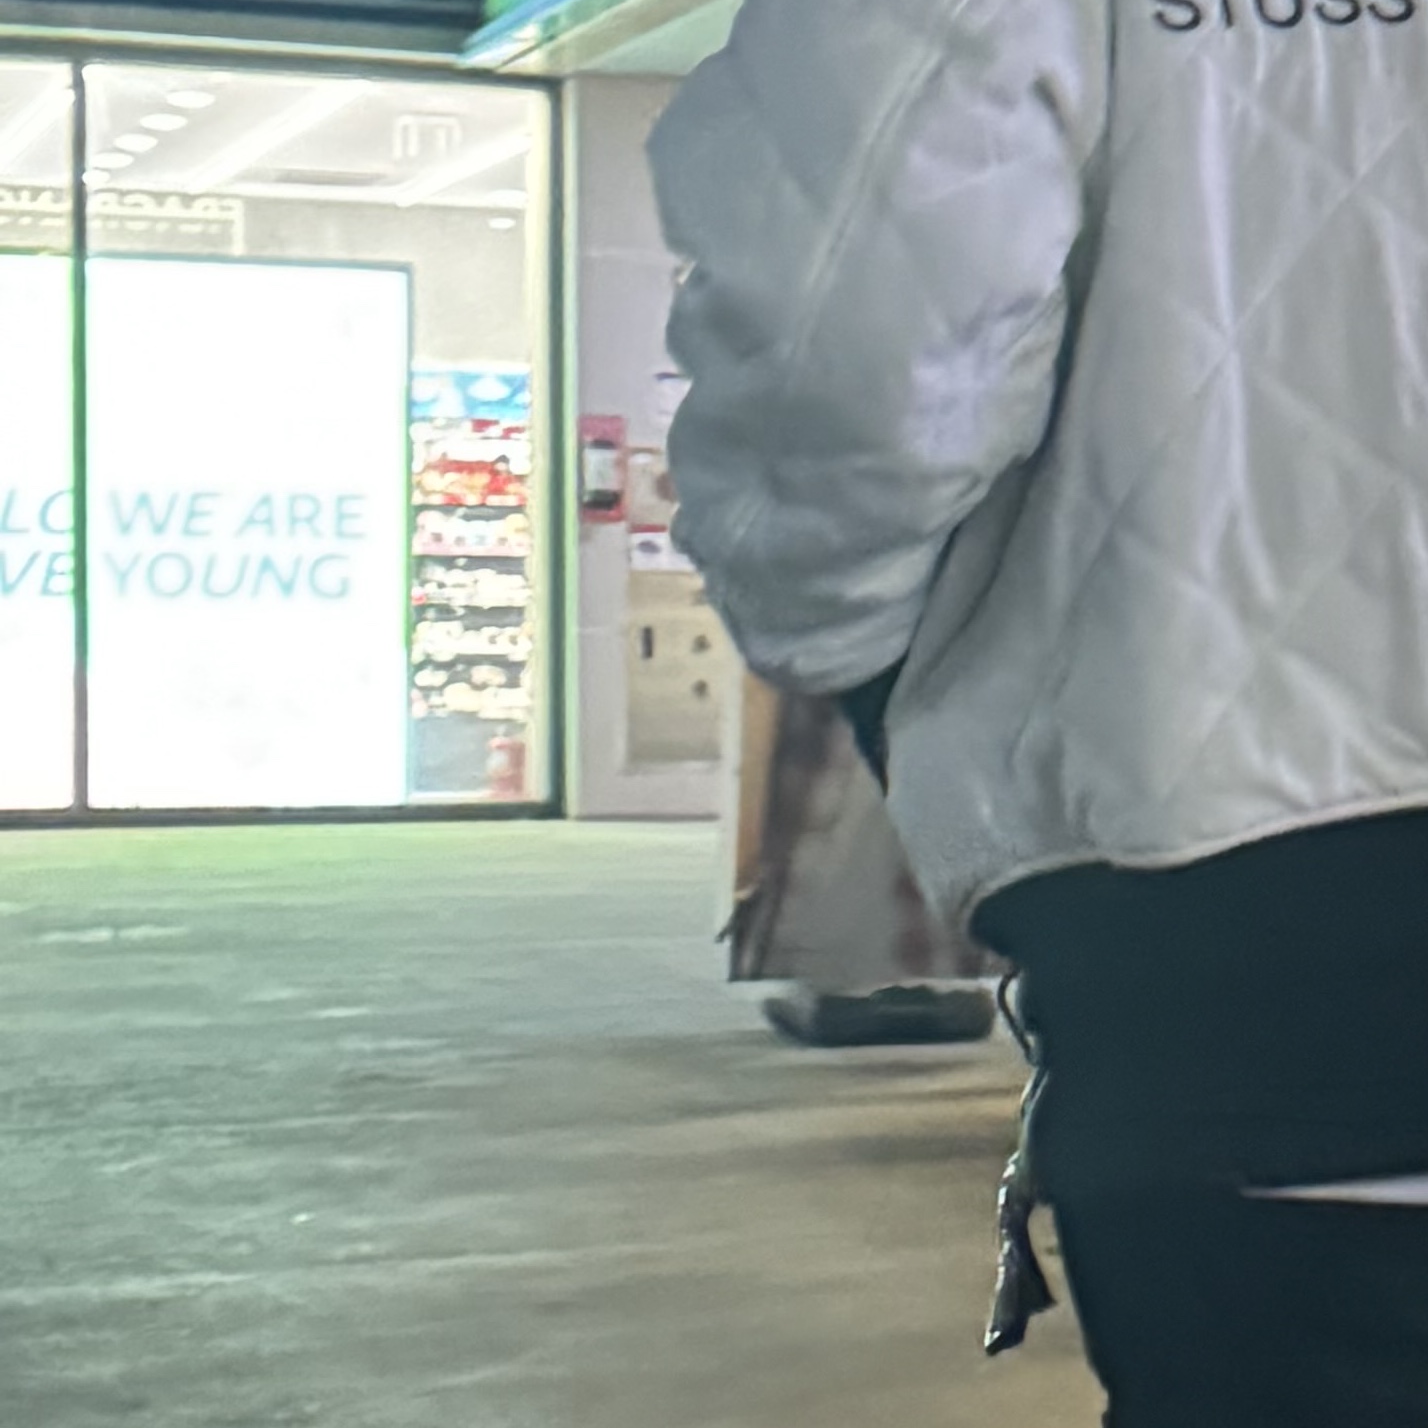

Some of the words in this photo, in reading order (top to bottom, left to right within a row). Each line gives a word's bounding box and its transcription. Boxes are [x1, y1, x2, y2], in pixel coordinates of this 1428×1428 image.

[108, 490, 226, 538] WE
[234, 492, 370, 541] ARE
[104, 550, 353, 601] YOUNG
